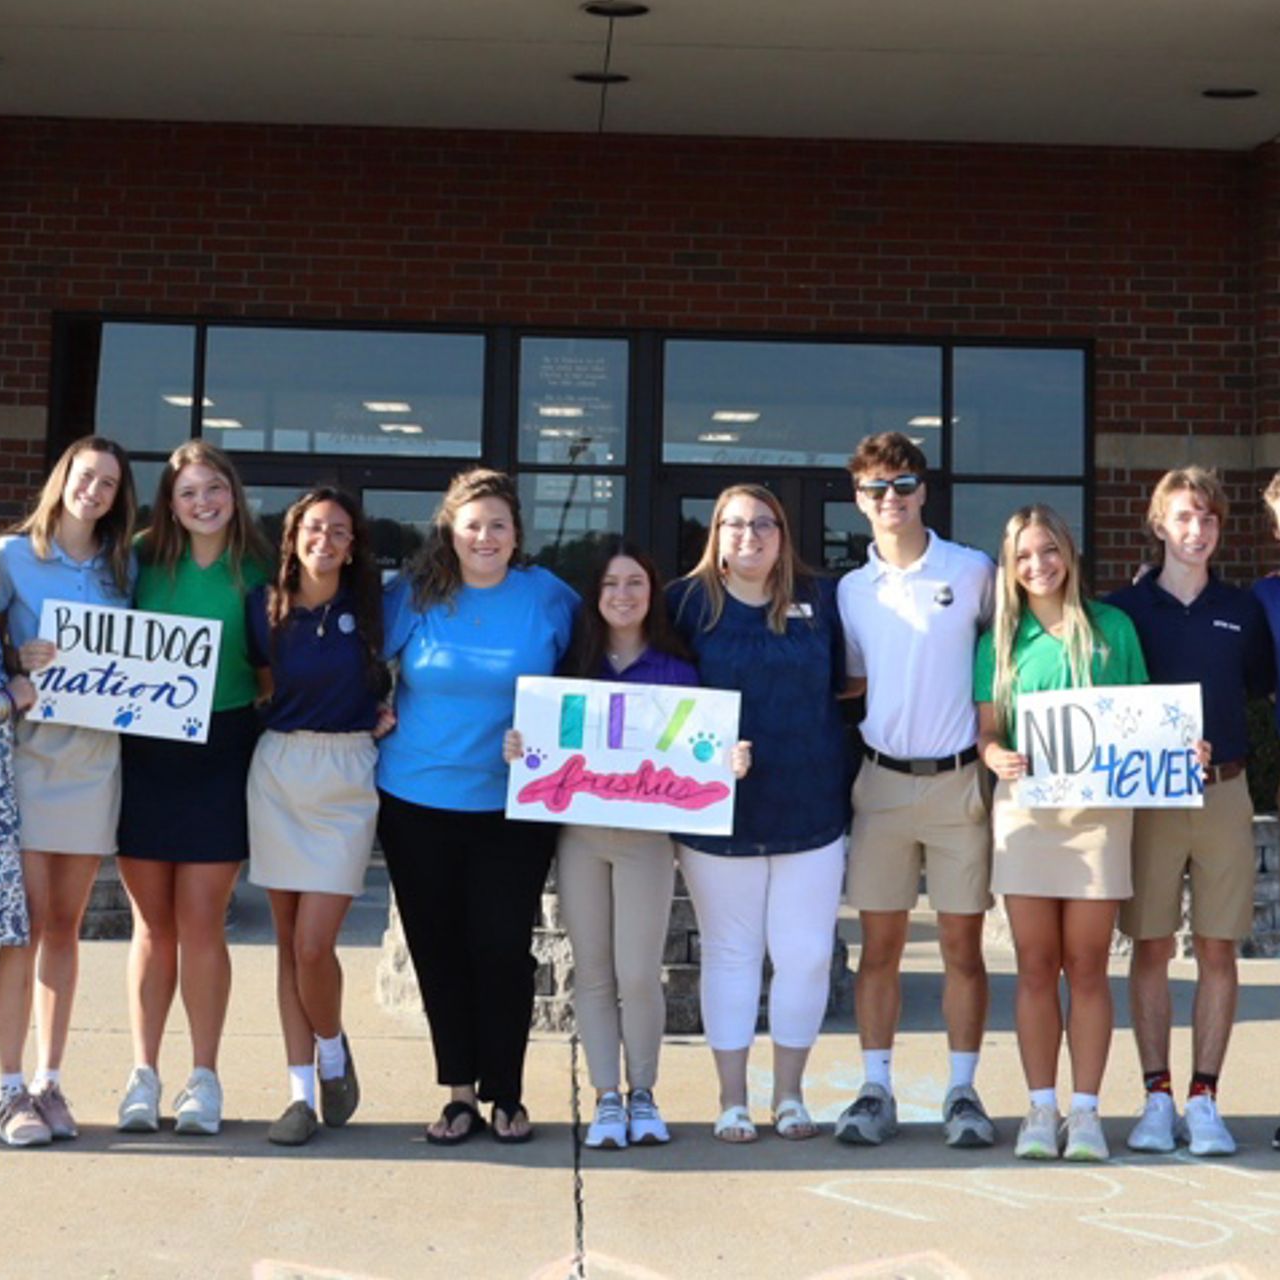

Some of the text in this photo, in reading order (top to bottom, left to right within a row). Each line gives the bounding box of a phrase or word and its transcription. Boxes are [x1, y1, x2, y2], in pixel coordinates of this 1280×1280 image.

[55, 606, 213, 669] BULLDOG
[38, 661, 199, 710] nation
[558, 692, 697, 752] HEY
[1023, 703, 1097, 777] ND
